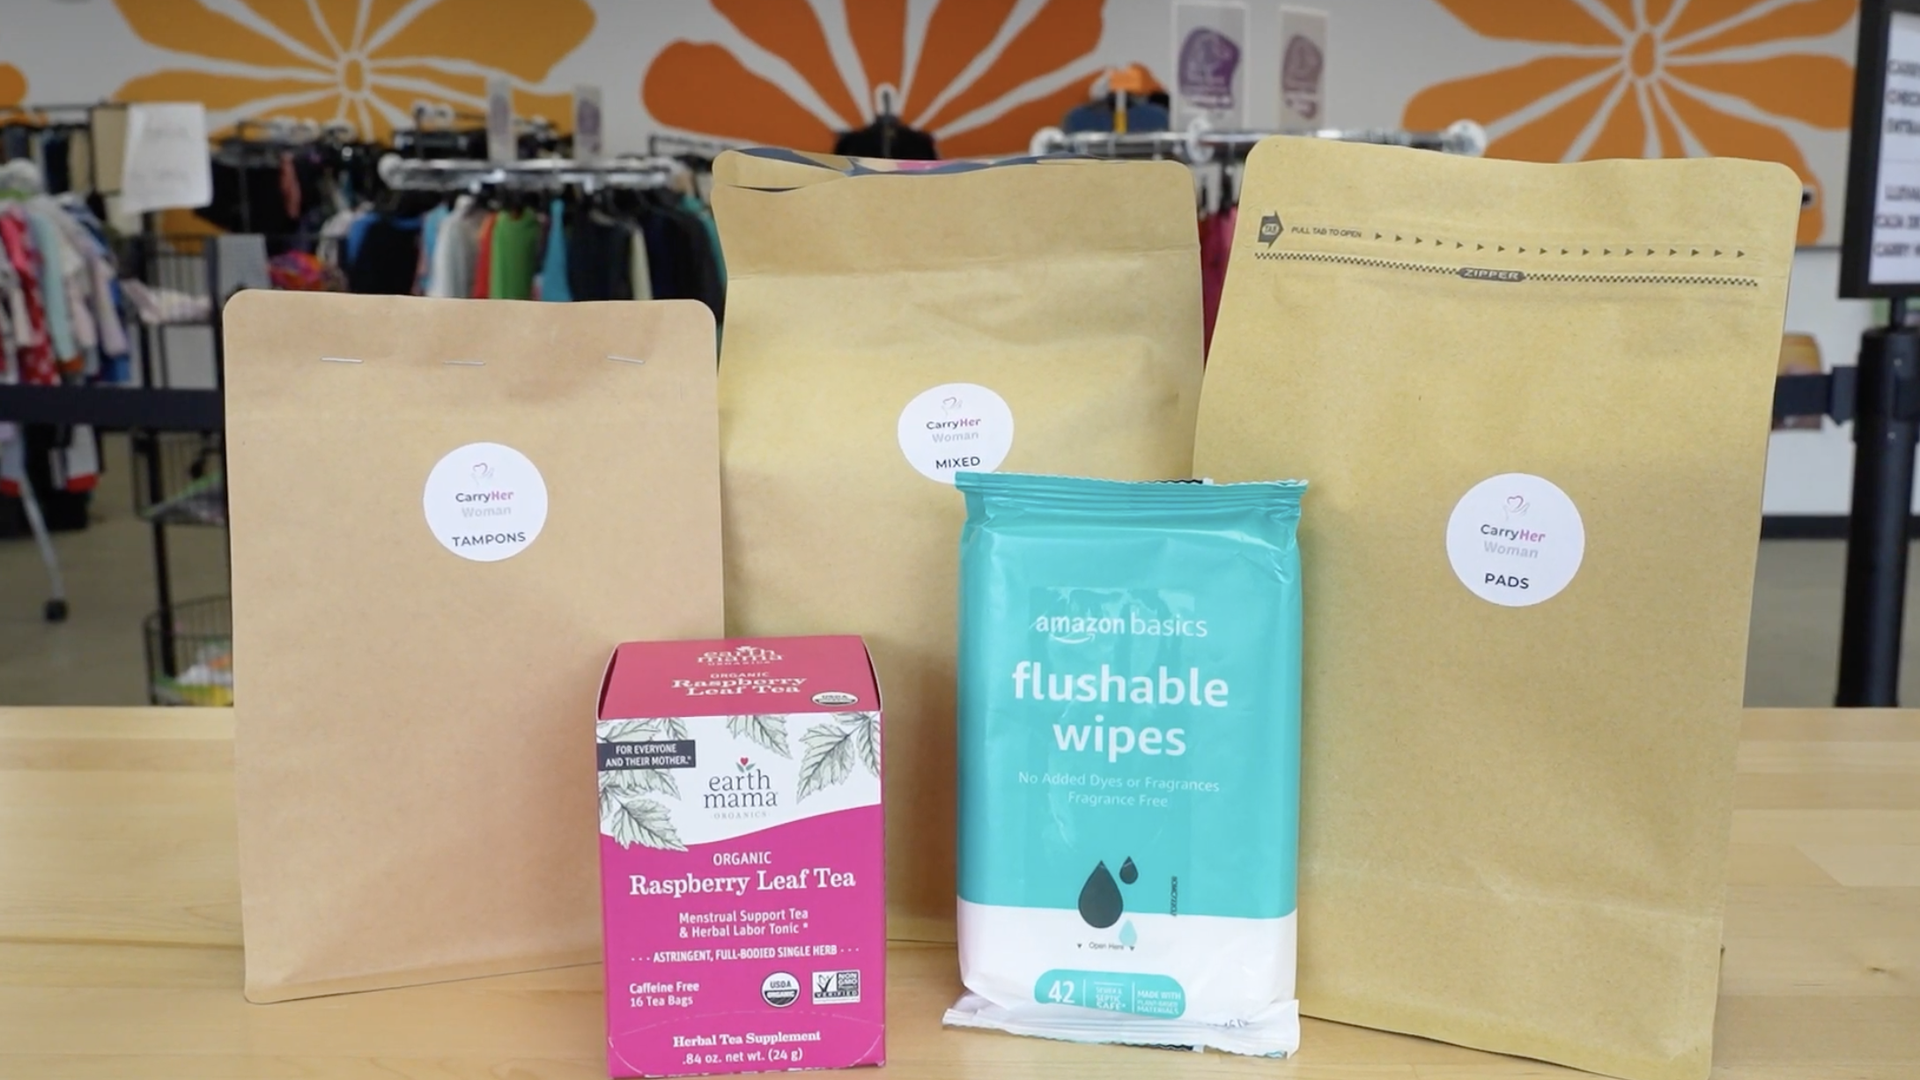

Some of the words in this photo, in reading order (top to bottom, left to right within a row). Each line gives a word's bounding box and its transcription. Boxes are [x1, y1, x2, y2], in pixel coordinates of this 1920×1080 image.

[1291, 226, 1310, 235] PULL
[1313, 227, 1327, 236] TAB
[1329, 228, 1339, 236] TO
[1340, 229, 1362, 238] OPEN
[1464, 268, 1519, 280] ZIPPER
[931, 431, 979, 444] Woman
[935, 456, 981, 470] MIXED
[461, 506, 511, 519] Woman
[452, 531, 526, 547] TAMPONS
[1483, 540, 1539, 559] Woman
[1484, 572, 1530, 590] PADS
[1035, 615, 1125, 636] amazon
[1130, 611, 1208, 638] basics
[710, 671, 770, 679] ORGANIC
[671, 676, 807, 689] Raspberry
[1011, 660, 1229, 708] flushable
[685, 685, 743, 696] Leaf
[751, 684, 801, 694] Tea
[1052, 714, 1187, 764] wipes
[615, 745, 633, 755] FOR
[634, 743, 677, 754] EVERYONE
[605, 757, 624, 768] AND
[625, 756, 650, 767] THEIR
[708, 768, 771, 791] earth
[1018, 771, 1038, 785] No
[1042, 771, 1086, 786] Added
[1089, 773, 1123, 791] Dyes
[1126, 777, 1141, 789] or
[1145, 776, 1220, 794] Fragrances
[703, 791, 777, 809] mama
[1067, 791, 1135, 808] Fragrance
[1138, 793, 1168, 808] Free
[713, 810, 768, 820] ORGANICS
[713, 851, 772, 866] ORGANIC
[629, 873, 751, 898] Raspberry
[757, 869, 809, 890] Leaf
[814, 868, 856, 888] Tea
[679, 910, 738, 925] Menstrual
[740, 909, 787, 925] Support
[789, 908, 808, 920] Tea
[679, 926, 688, 938] &
[692, 924, 730, 938] Herbal
[733, 924, 767, 937] Labor
[769, 922, 799, 935] Tonic
[1088, 941, 1107, 950] Open
[653, 951, 714, 963] ASTRINGENT,
[715, 947, 776, 960] FULL-BODIED
[777, 946, 811, 958] SINGLE
[813, 945, 838, 956] HERB
[629, 982, 673, 995] Caffeine
[676, 981, 700, 992] Free
[769, 980, 792, 989] USDA
[1048, 979, 1076, 1004] 42
[815, 990, 858, 998] VERIFIED
[1137, 990, 1159, 1000] MADE
[1161, 991, 1182, 1000] WITH
[630, 997, 643, 1007] 16
[646, 996, 665, 1007] Tea
[668, 995, 693, 1008] Bags
[1137, 1005, 1180, 1014] MATERIALS
[673, 1035, 716, 1048] Herbal
[719, 1034, 743, 1046] Tea
[746, 1031, 821, 1046] Supplement
[682, 1052, 702, 1064] .84
[705, 1055, 722, 1064] oz.
[725, 1051, 744, 1062] net
[746, 1050, 765, 1061] wt.
[768, 1048, 788, 1062] (24
[791, 1047, 803, 1062] g)
